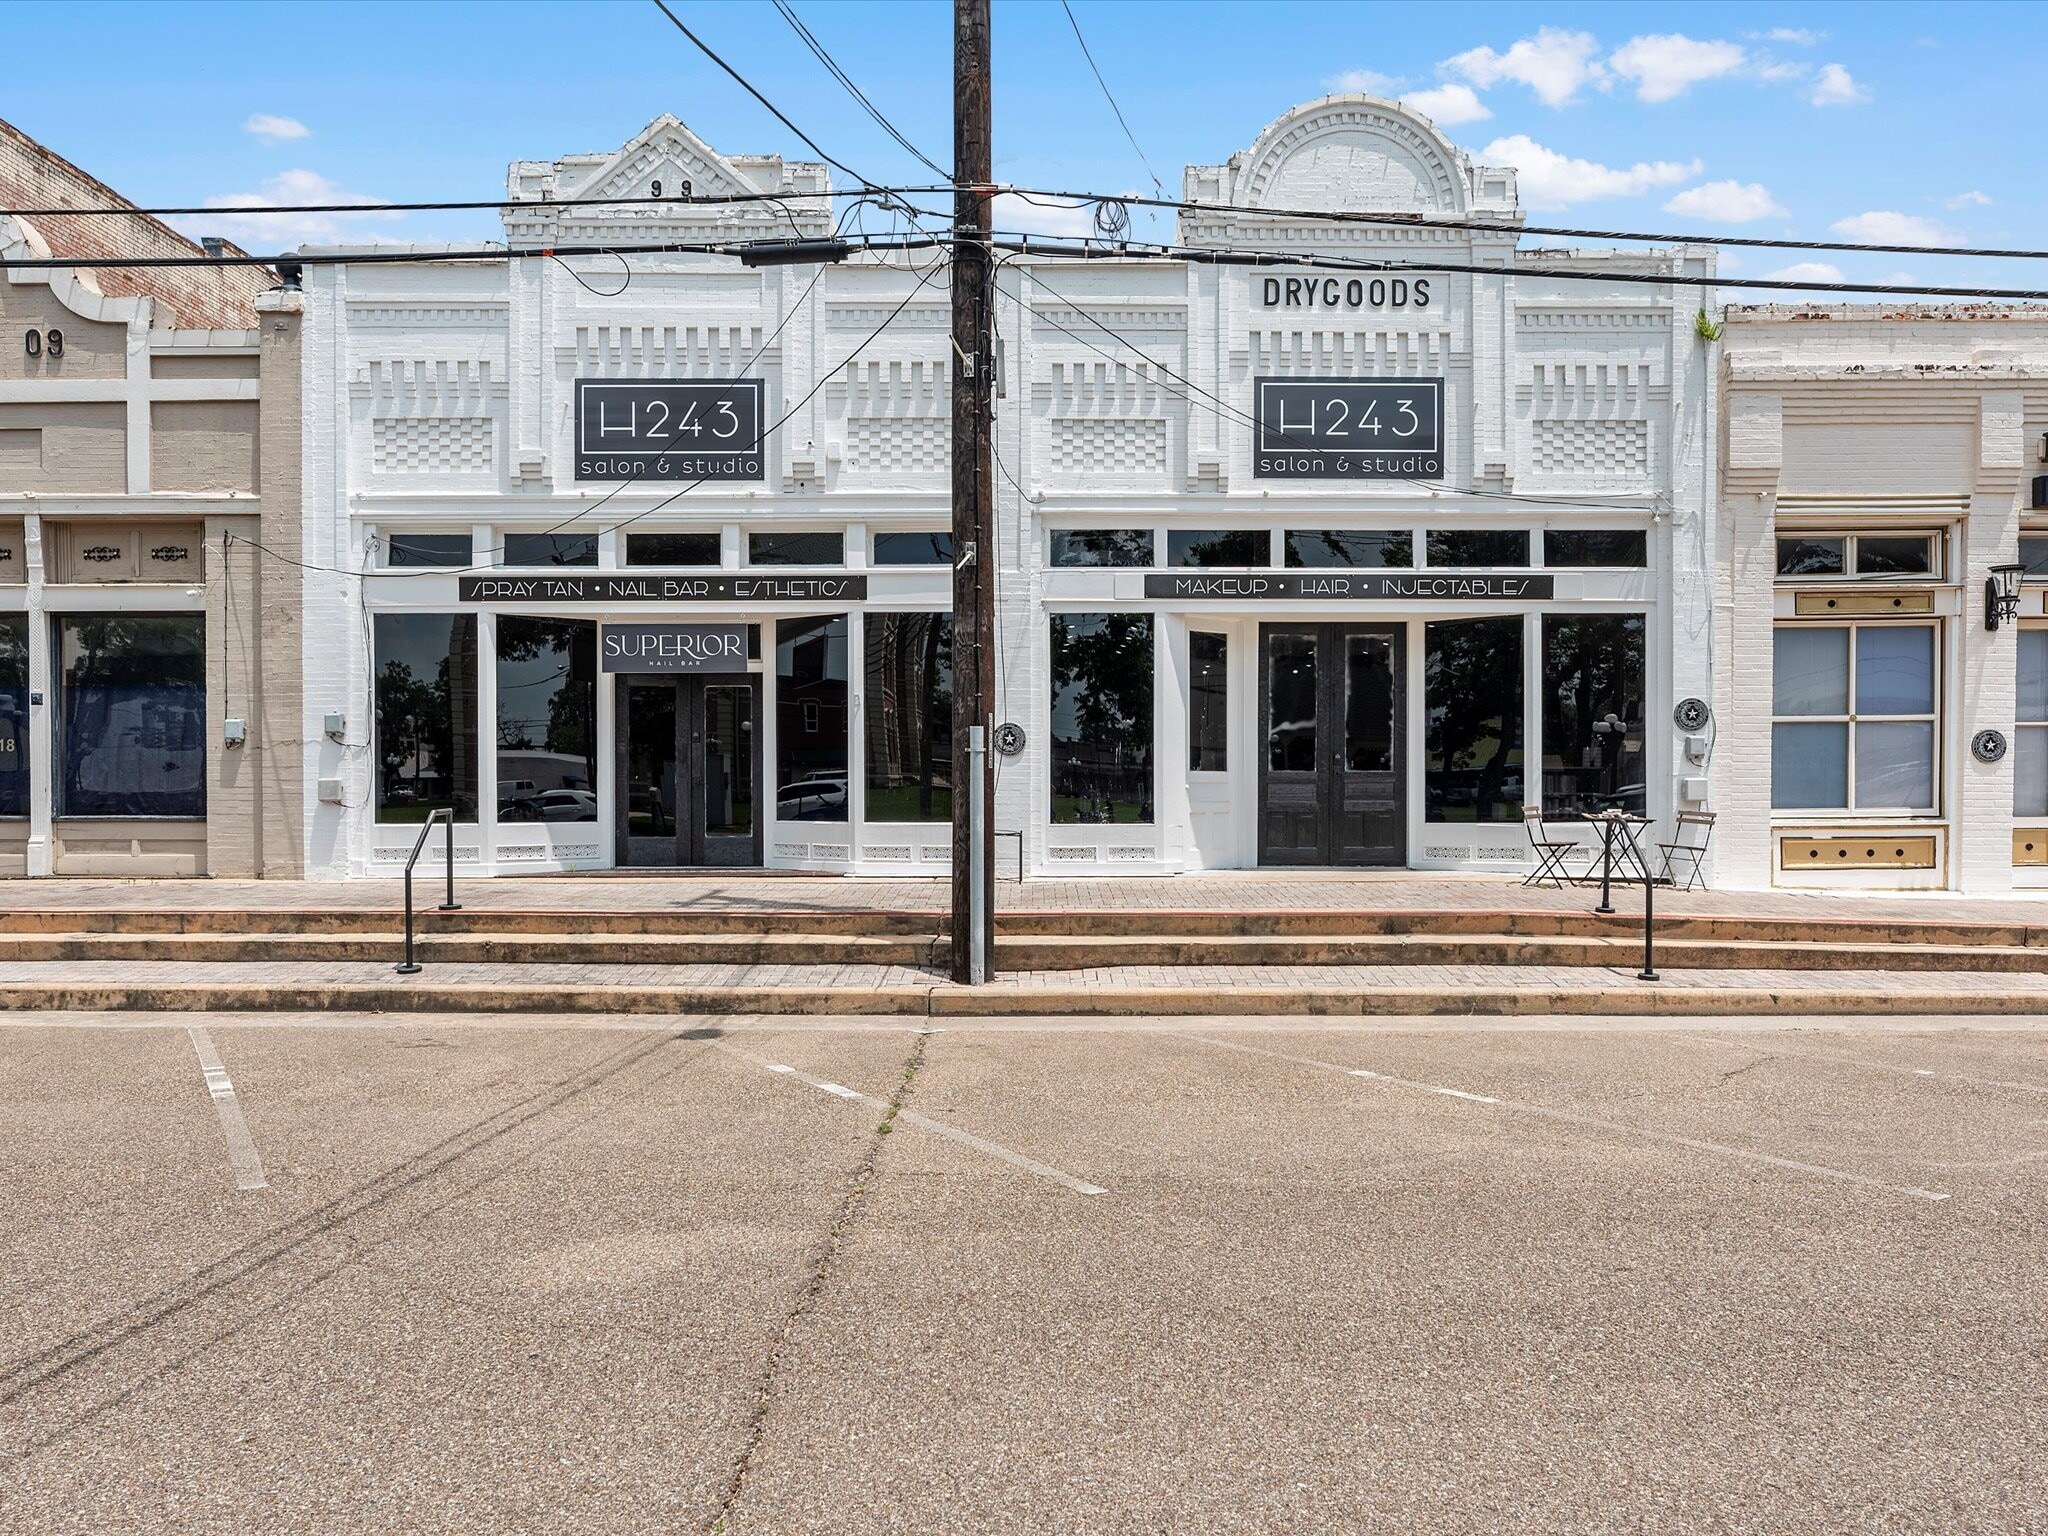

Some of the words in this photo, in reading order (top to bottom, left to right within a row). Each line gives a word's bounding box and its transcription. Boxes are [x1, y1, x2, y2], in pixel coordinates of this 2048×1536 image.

[1263, 278, 1430, 307] DRYGOODS
[26, 329, 63, 356] 09
[600, 401, 739, 438] H243
[1280, 399, 1419, 436] H243
[581, 458, 645, 474] salon
[657, 458, 670, 474] &
[682, 458, 758, 474] studio
[1260, 456, 1325, 472] salon
[1336, 456, 1350, 472] &
[1361, 456, 1438, 473] studio
[471, 581, 538, 597] SPRAY
[543, 581, 583, 597] TAN
[609, 581, 658, 597] NAIL
[664, 581, 709, 597] BAR
[734, 580, 850, 597] ESTHETICS
[1175, 579, 1269, 595] MAKEUP
[1301, 579, 1350, 595] HAIR
[1382, 579, 1530, 596] INJECTABLES
[605, 634, 743, 660] SUPERIOR
